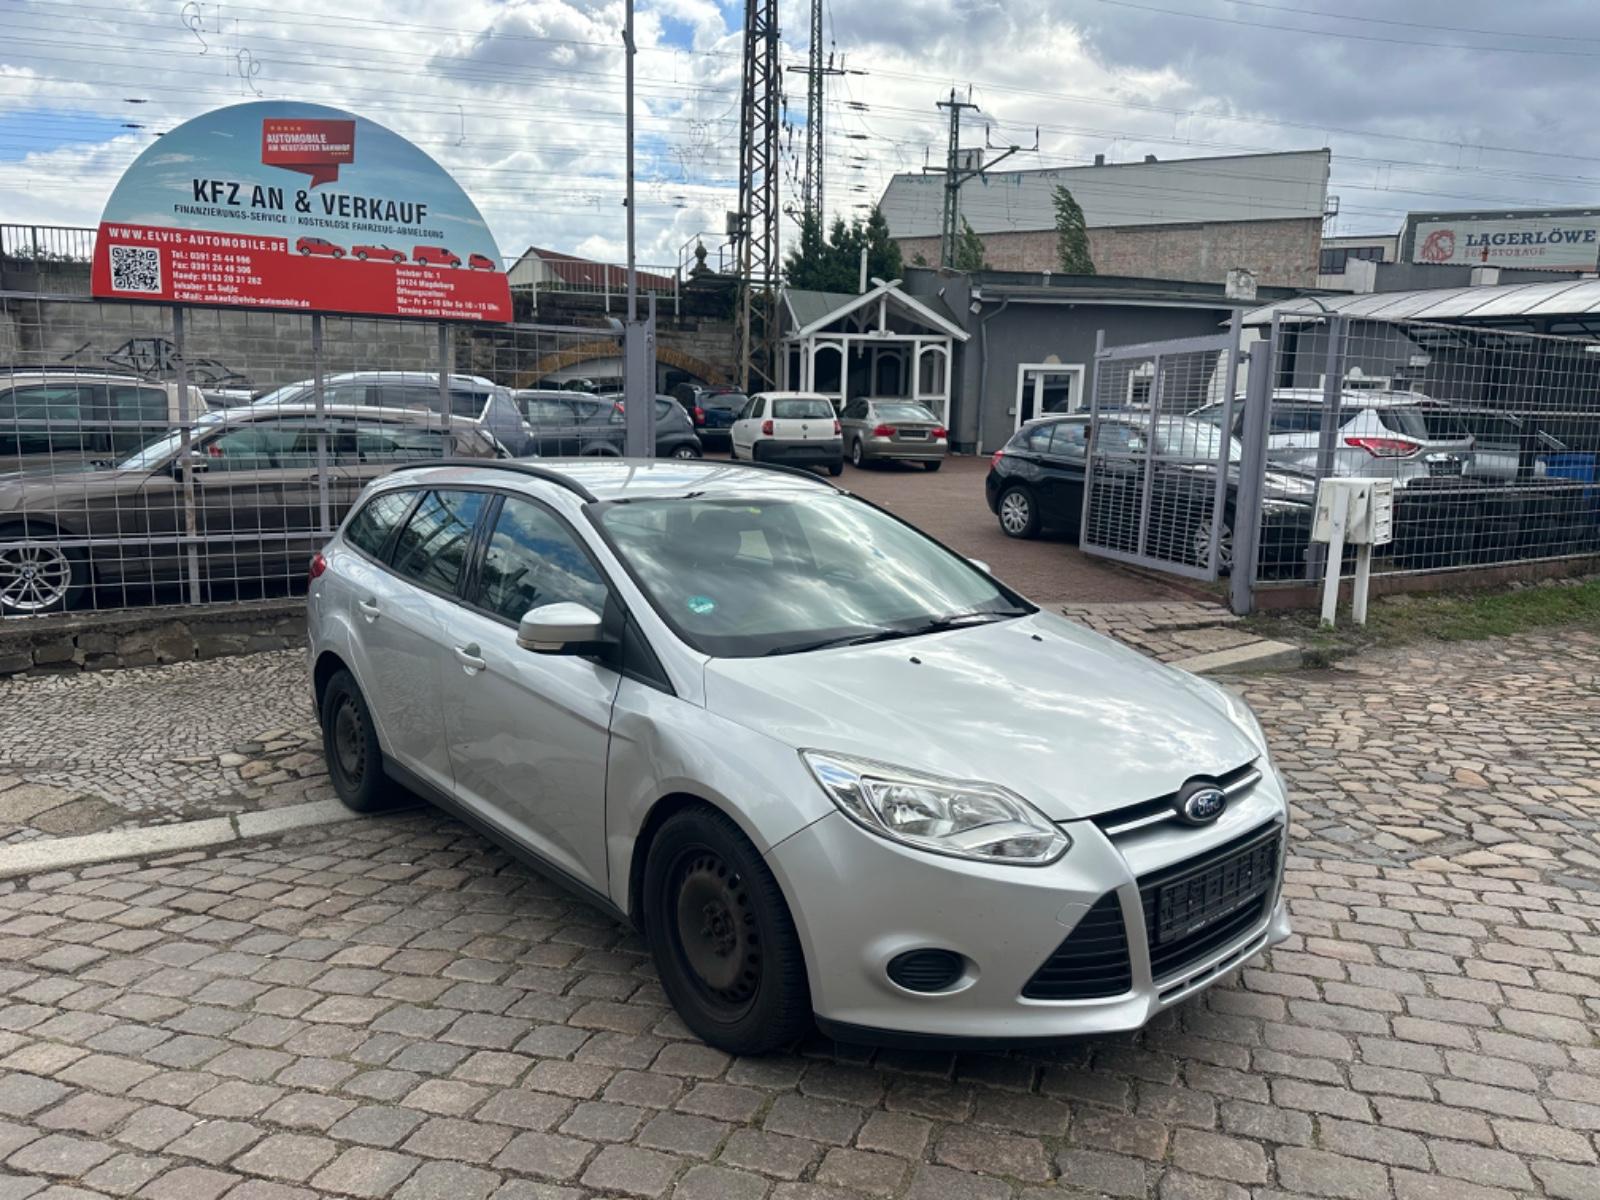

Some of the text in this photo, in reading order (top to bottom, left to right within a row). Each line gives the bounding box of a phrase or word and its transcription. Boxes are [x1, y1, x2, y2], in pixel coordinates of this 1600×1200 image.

[267, 132, 327, 143] AUTOMOBILE
[193, 178, 428, 225] KFZ AN & VERKAUF
[174, 203, 287, 224] FINANZIERUNGS-SERVICE
[298, 216, 350, 230] KOSTENLOSE
[108, 227, 286, 252] WWW.ELVIS-AUTOMOBILE.DE
[1465, 227, 1596, 247] LAGERLÖWE
[171, 250, 188, 259] Tel.:
[224, 254, 235, 263] 44
[172, 260, 189, 269] Fax:
[173, 271, 200, 281] Handy:
[174, 291, 202, 301] E-Mail:
